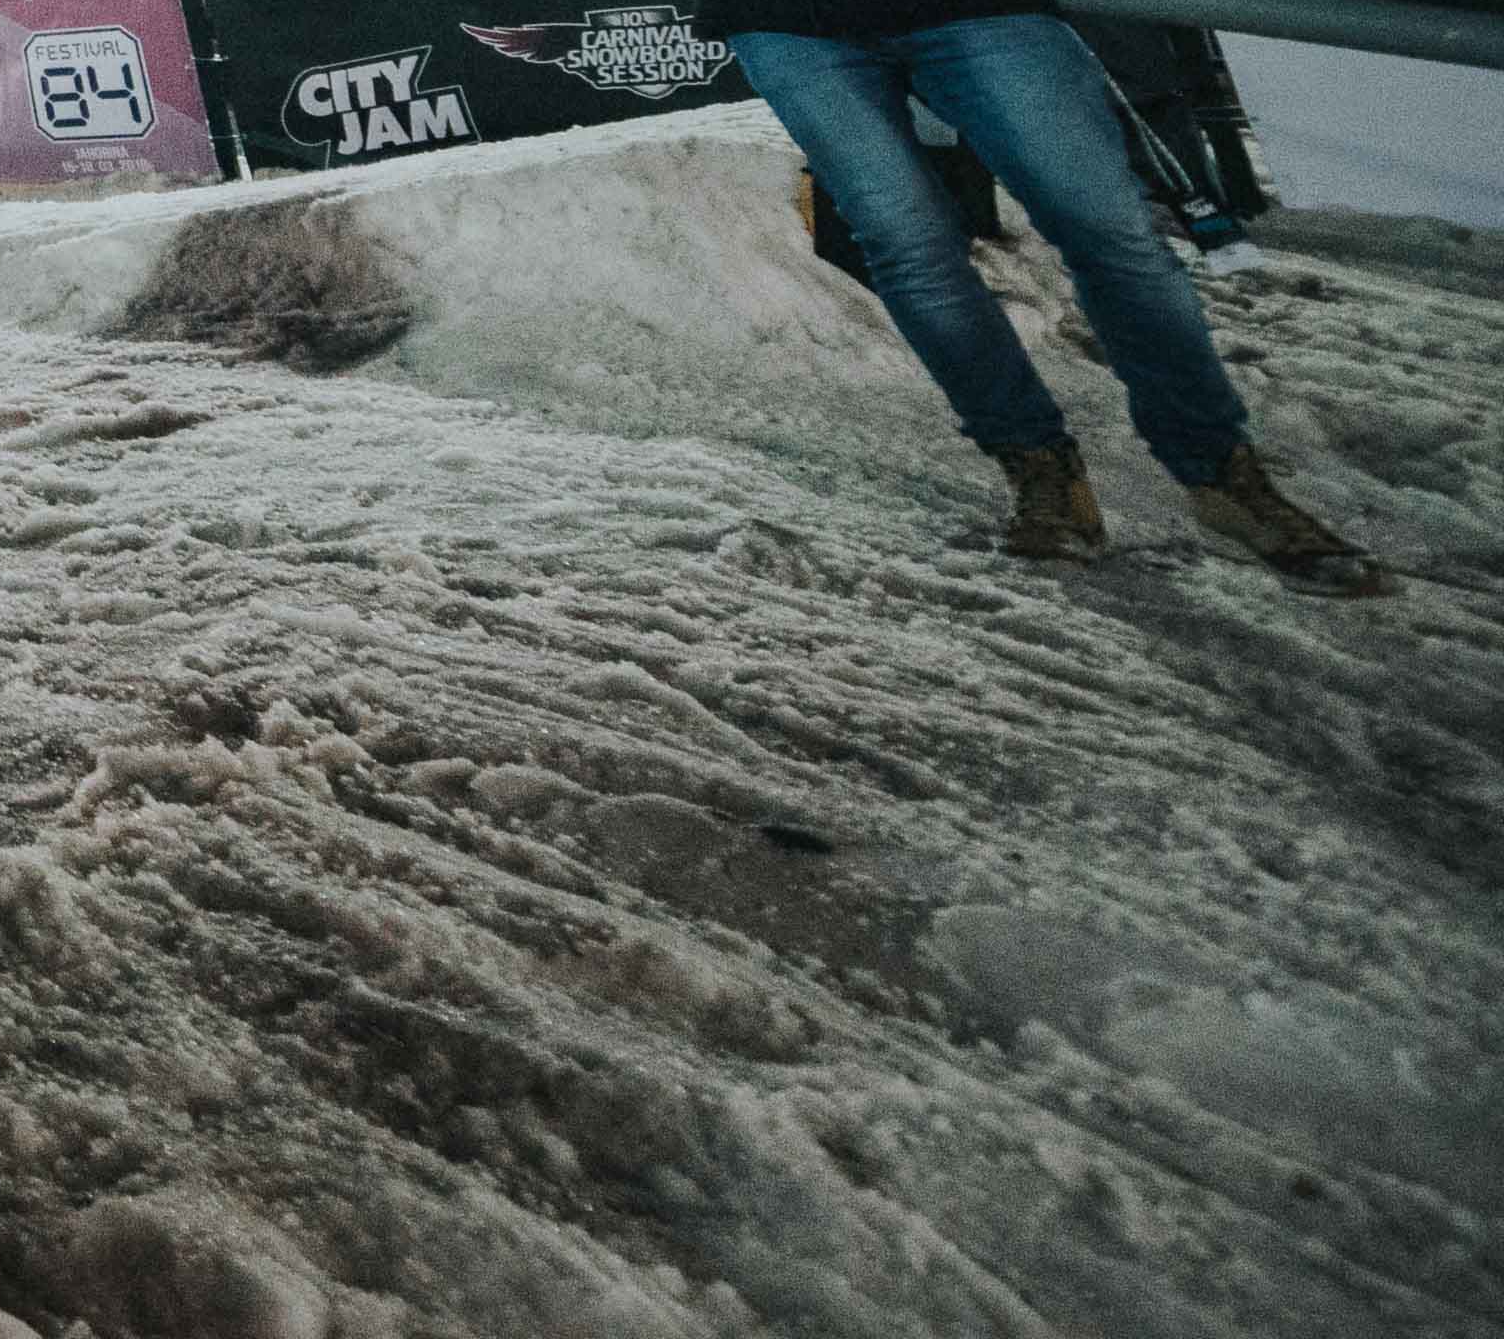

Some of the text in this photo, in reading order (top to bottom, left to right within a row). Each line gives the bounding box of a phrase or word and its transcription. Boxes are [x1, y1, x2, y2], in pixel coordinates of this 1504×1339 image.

[34, 39, 129, 62] FESTIVAL
[581, 24, 699, 49] CARNIVAL
[567, 40, 727, 69] SNOWBOARD
[298, 54, 420, 118] CITY
[597, 60, 705, 84] SESSION
[40, 63, 143, 128] 84
[336, 93, 471, 156] JAM
